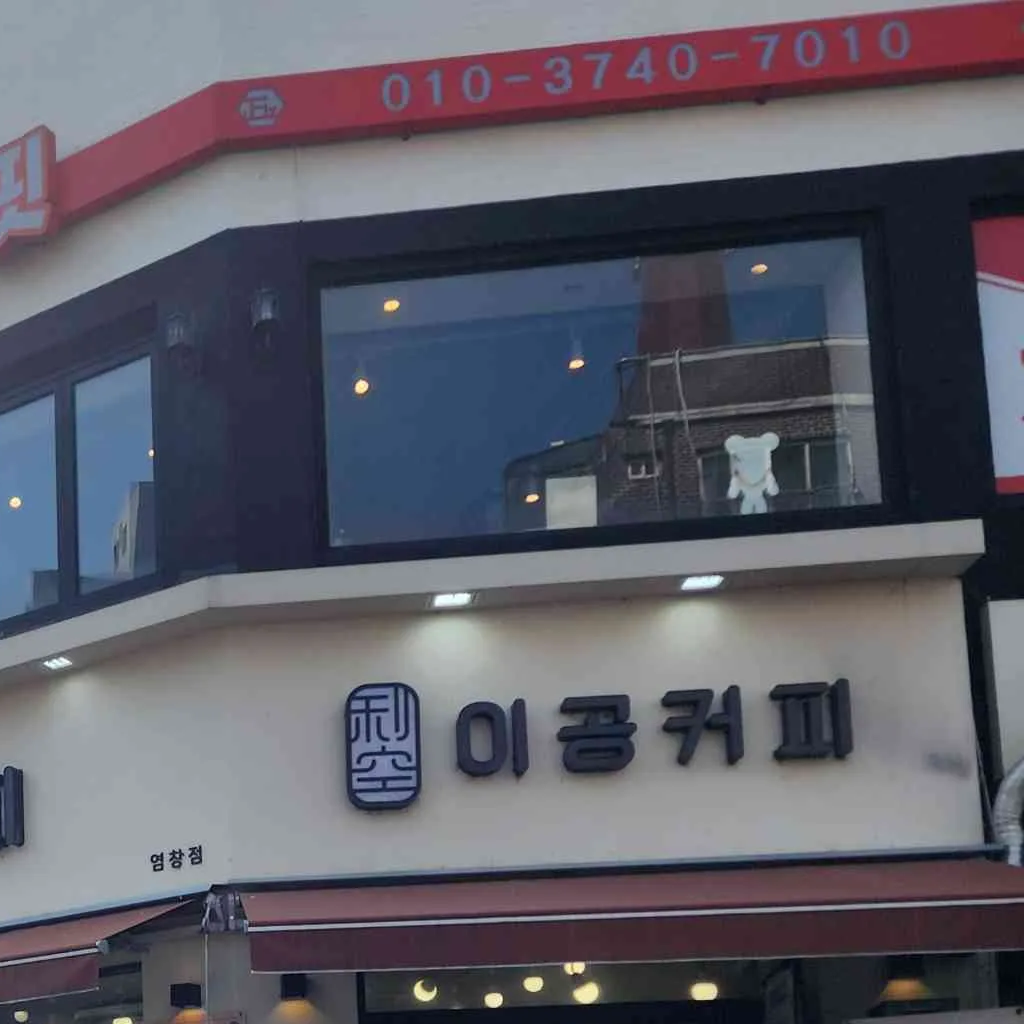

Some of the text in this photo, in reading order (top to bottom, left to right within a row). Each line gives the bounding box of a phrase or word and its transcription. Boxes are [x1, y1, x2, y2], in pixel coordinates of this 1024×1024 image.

[380, 19, 912, 113] 010-3740-7010
[455, 677, 854, 779] 이공커피
[150, 844, 203, 873] 염창점
